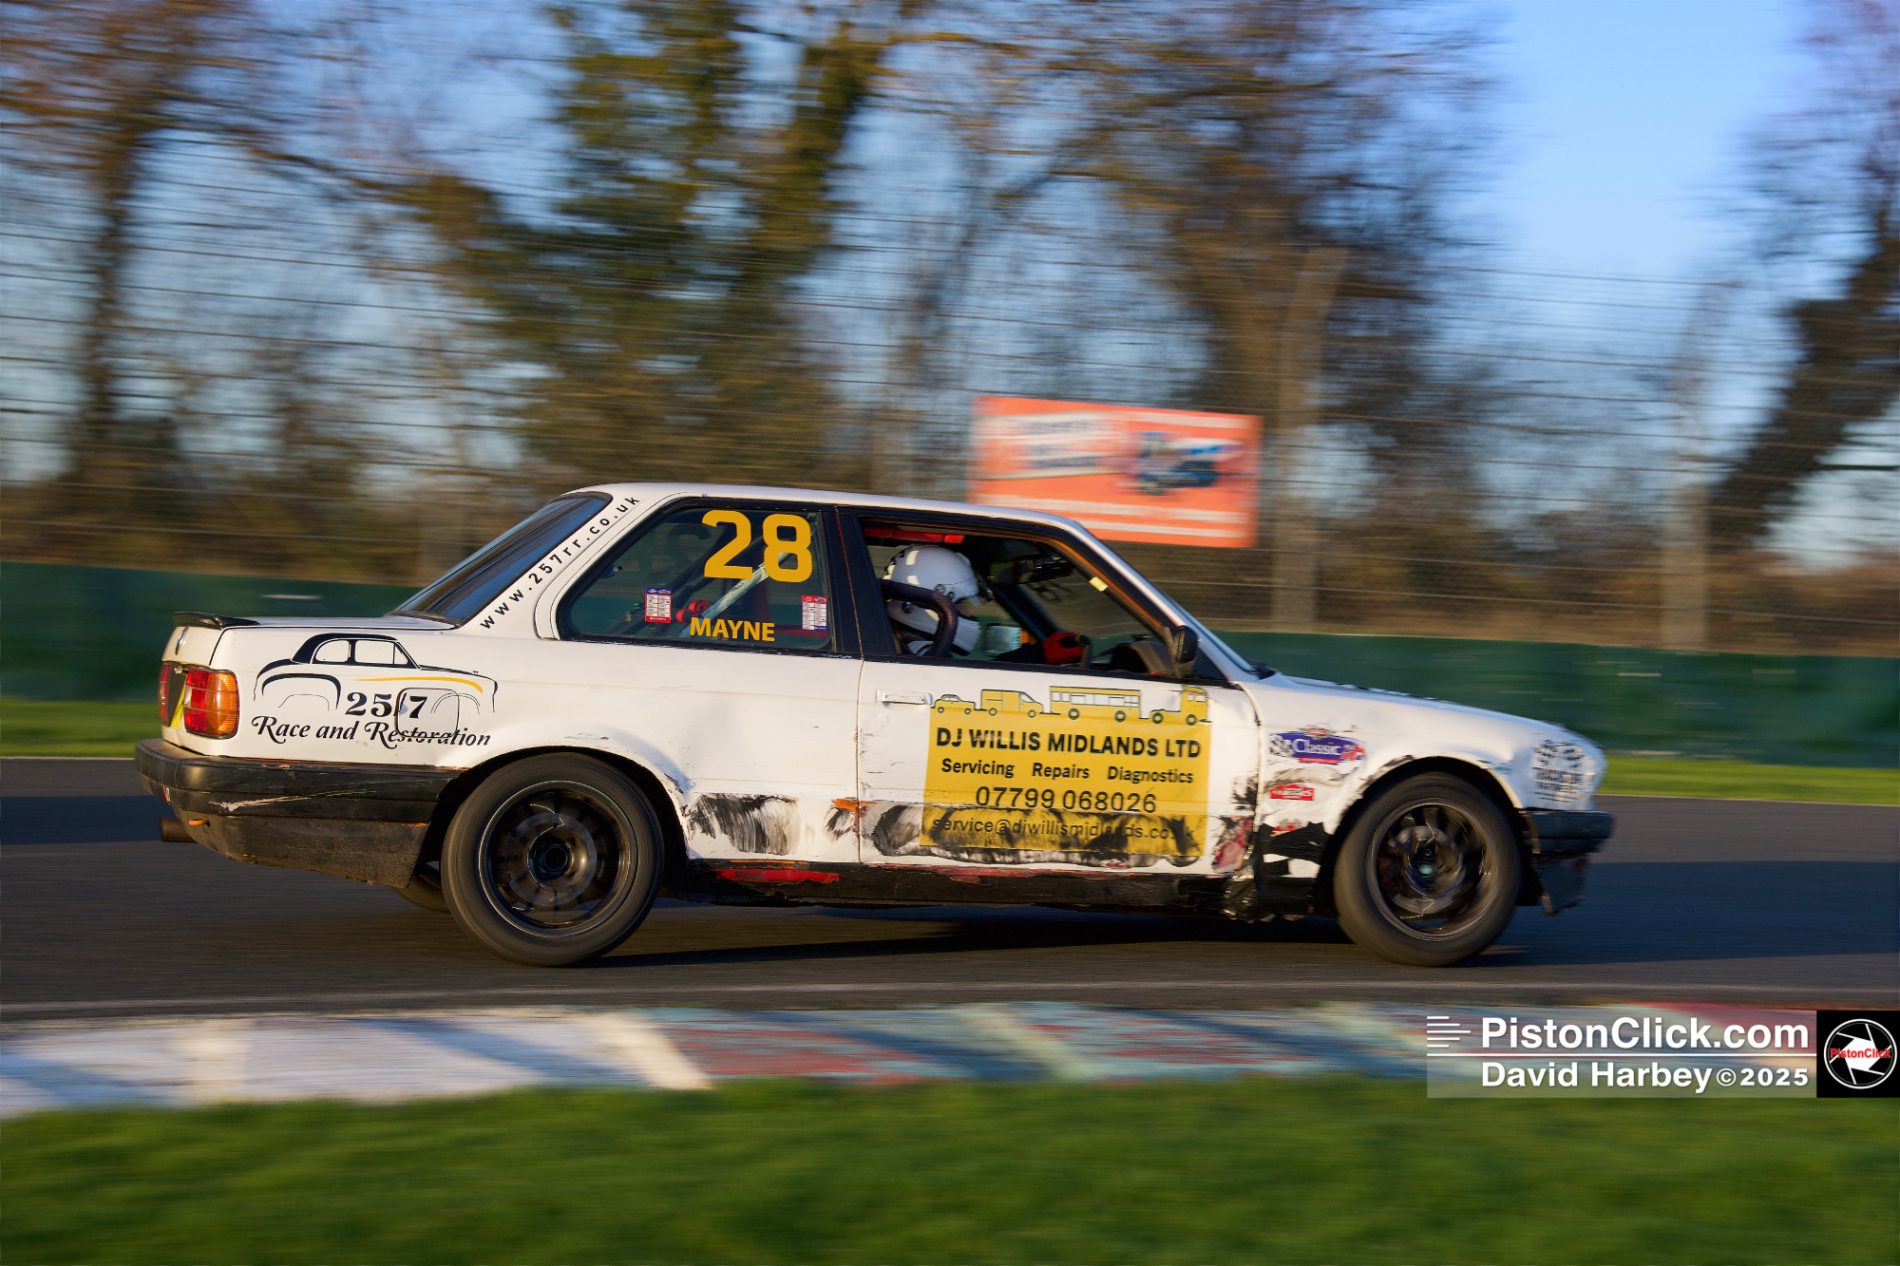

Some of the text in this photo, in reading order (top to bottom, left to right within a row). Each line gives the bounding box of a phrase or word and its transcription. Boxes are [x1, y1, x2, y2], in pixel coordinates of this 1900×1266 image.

[702, 509, 813, 583] 28
[480, 497, 640, 629] www.257rr.co.uk
[689, 616, 775, 642] MAYNE
[251, 715, 491, 749] Race and Restoration
[936, 727, 1201, 758] DJ WILLIS MIDLANDS LTD
[1291, 738, 1342, 755] Classic
[941, 758, 1194, 785] Servicing Repairs Diagnostics
[975, 786, 1156, 813] 07799 068026
